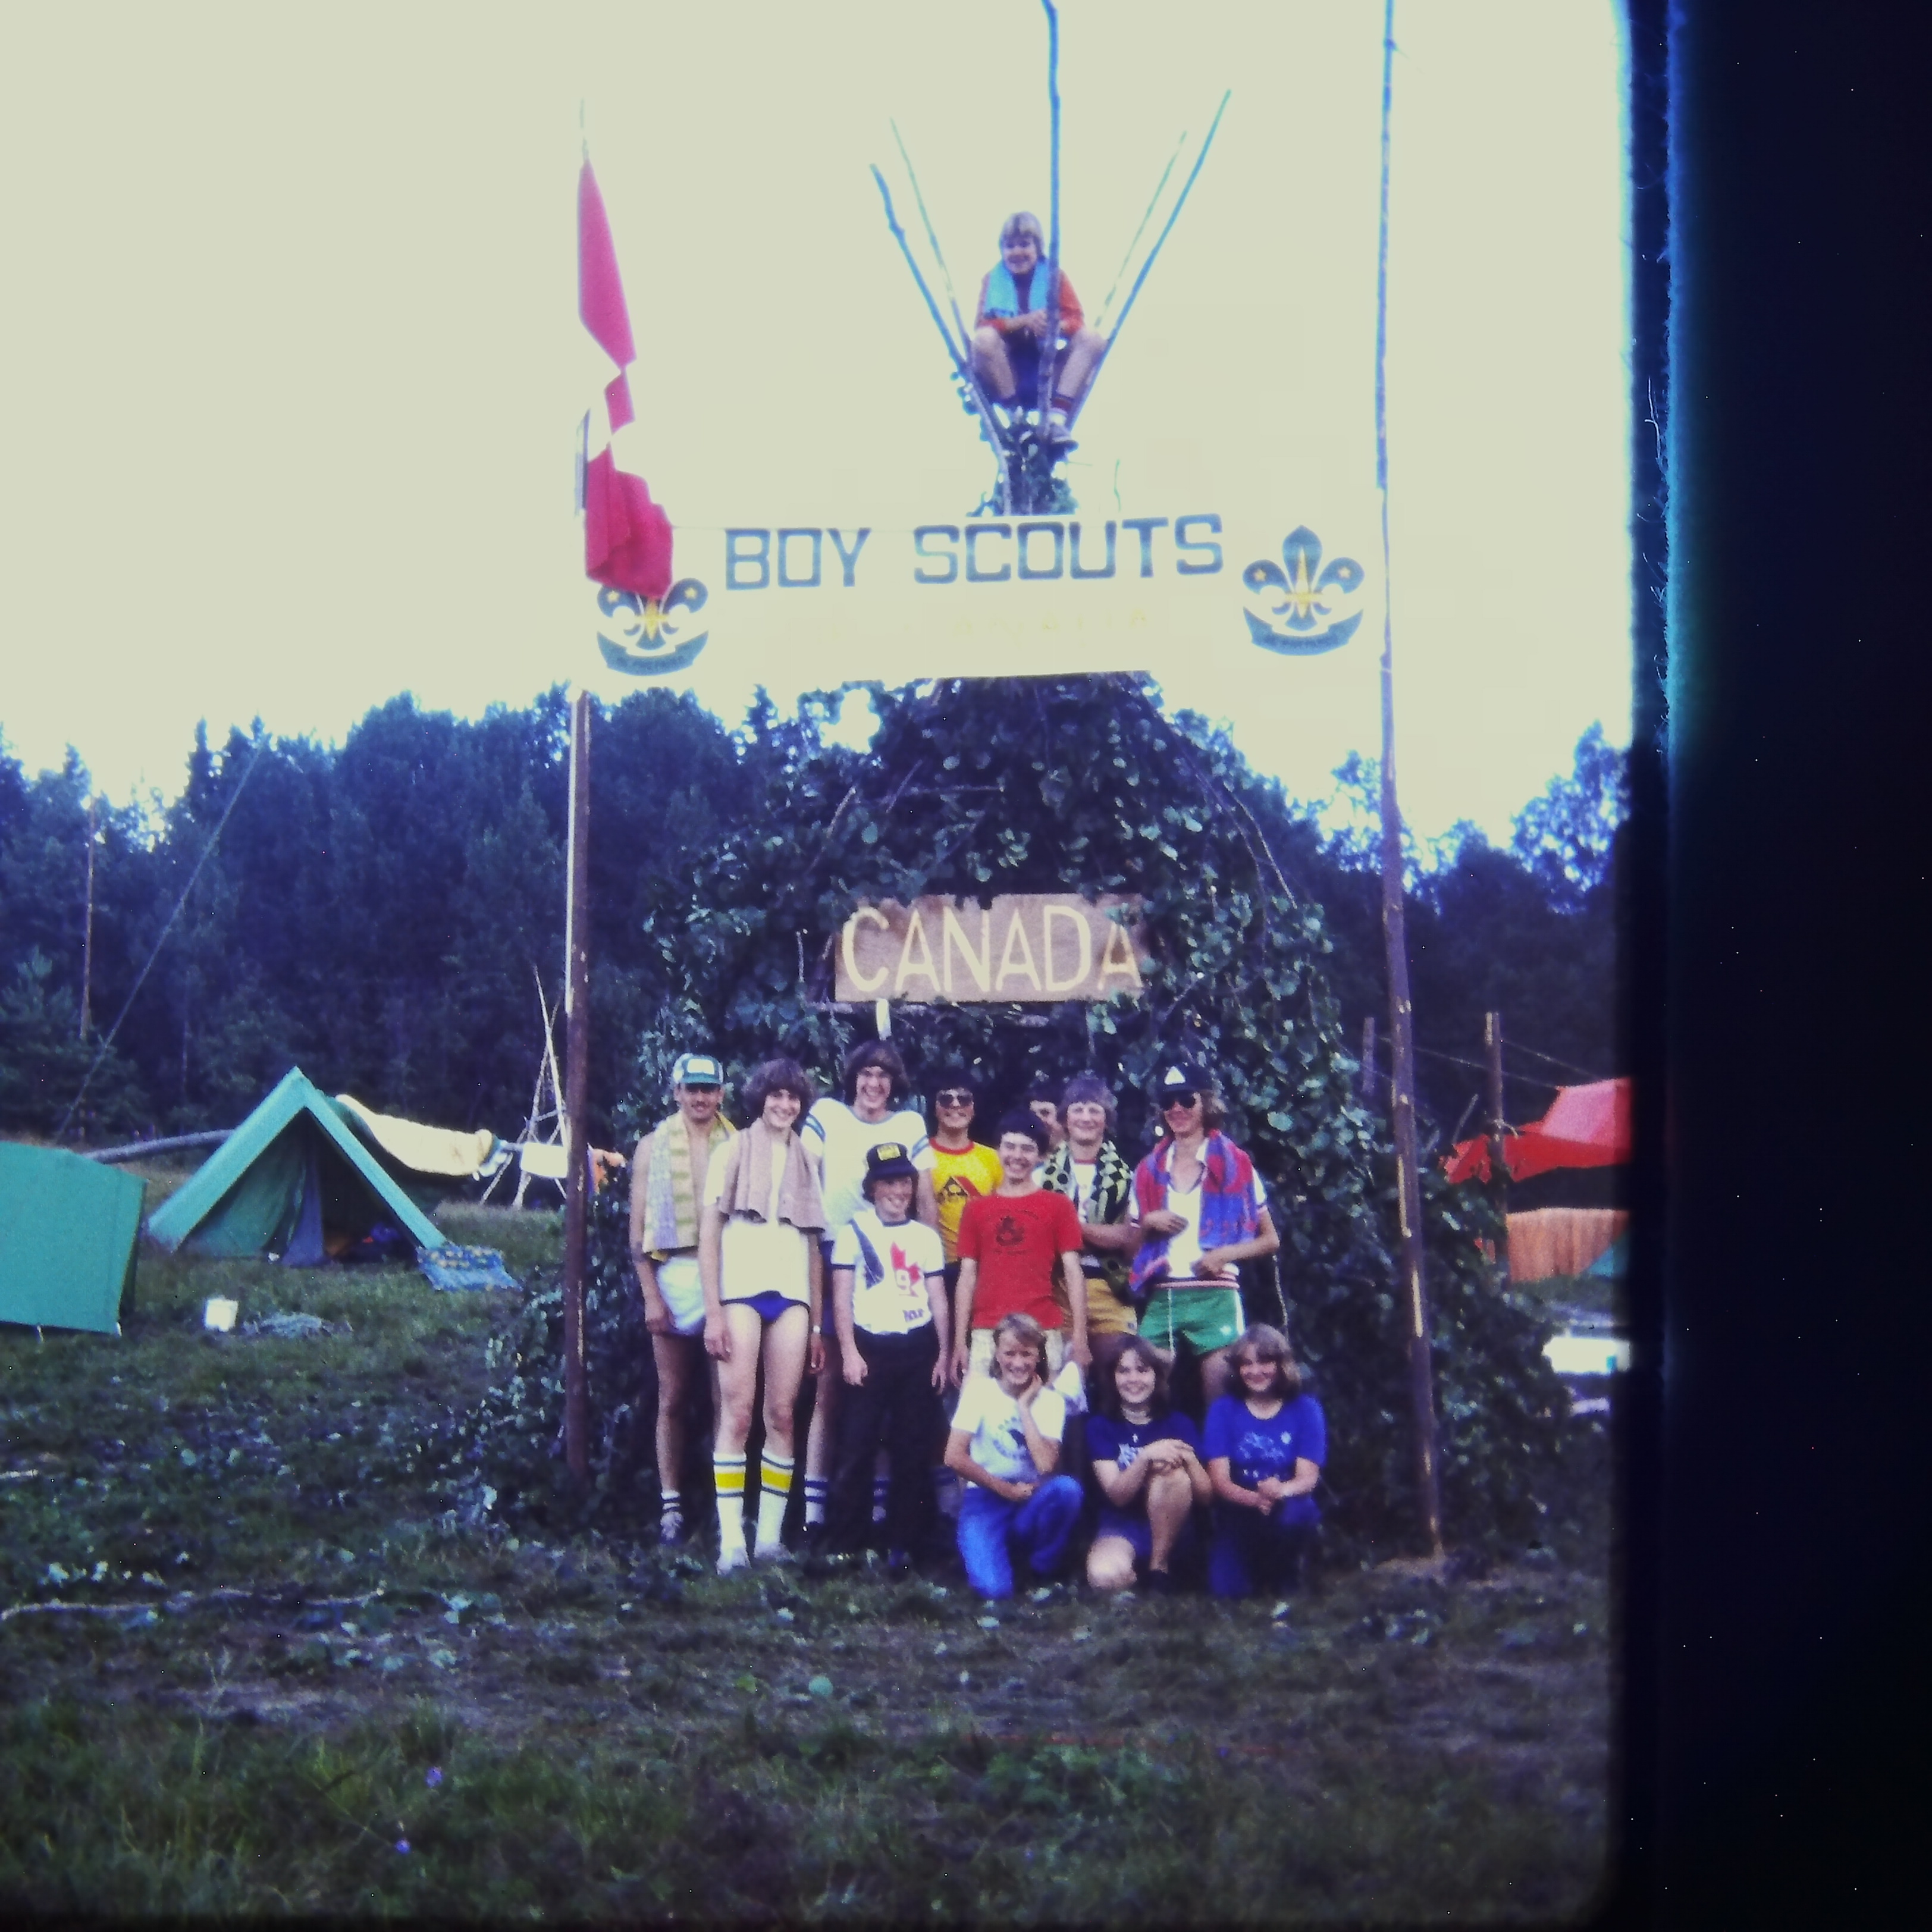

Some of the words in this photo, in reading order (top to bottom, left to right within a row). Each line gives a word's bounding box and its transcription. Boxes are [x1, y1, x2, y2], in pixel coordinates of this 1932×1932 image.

[725, 528, 871, 590] BOY
[914, 514, 1223, 584] SCOUTS
[842, 905, 1143, 992] CANADA
